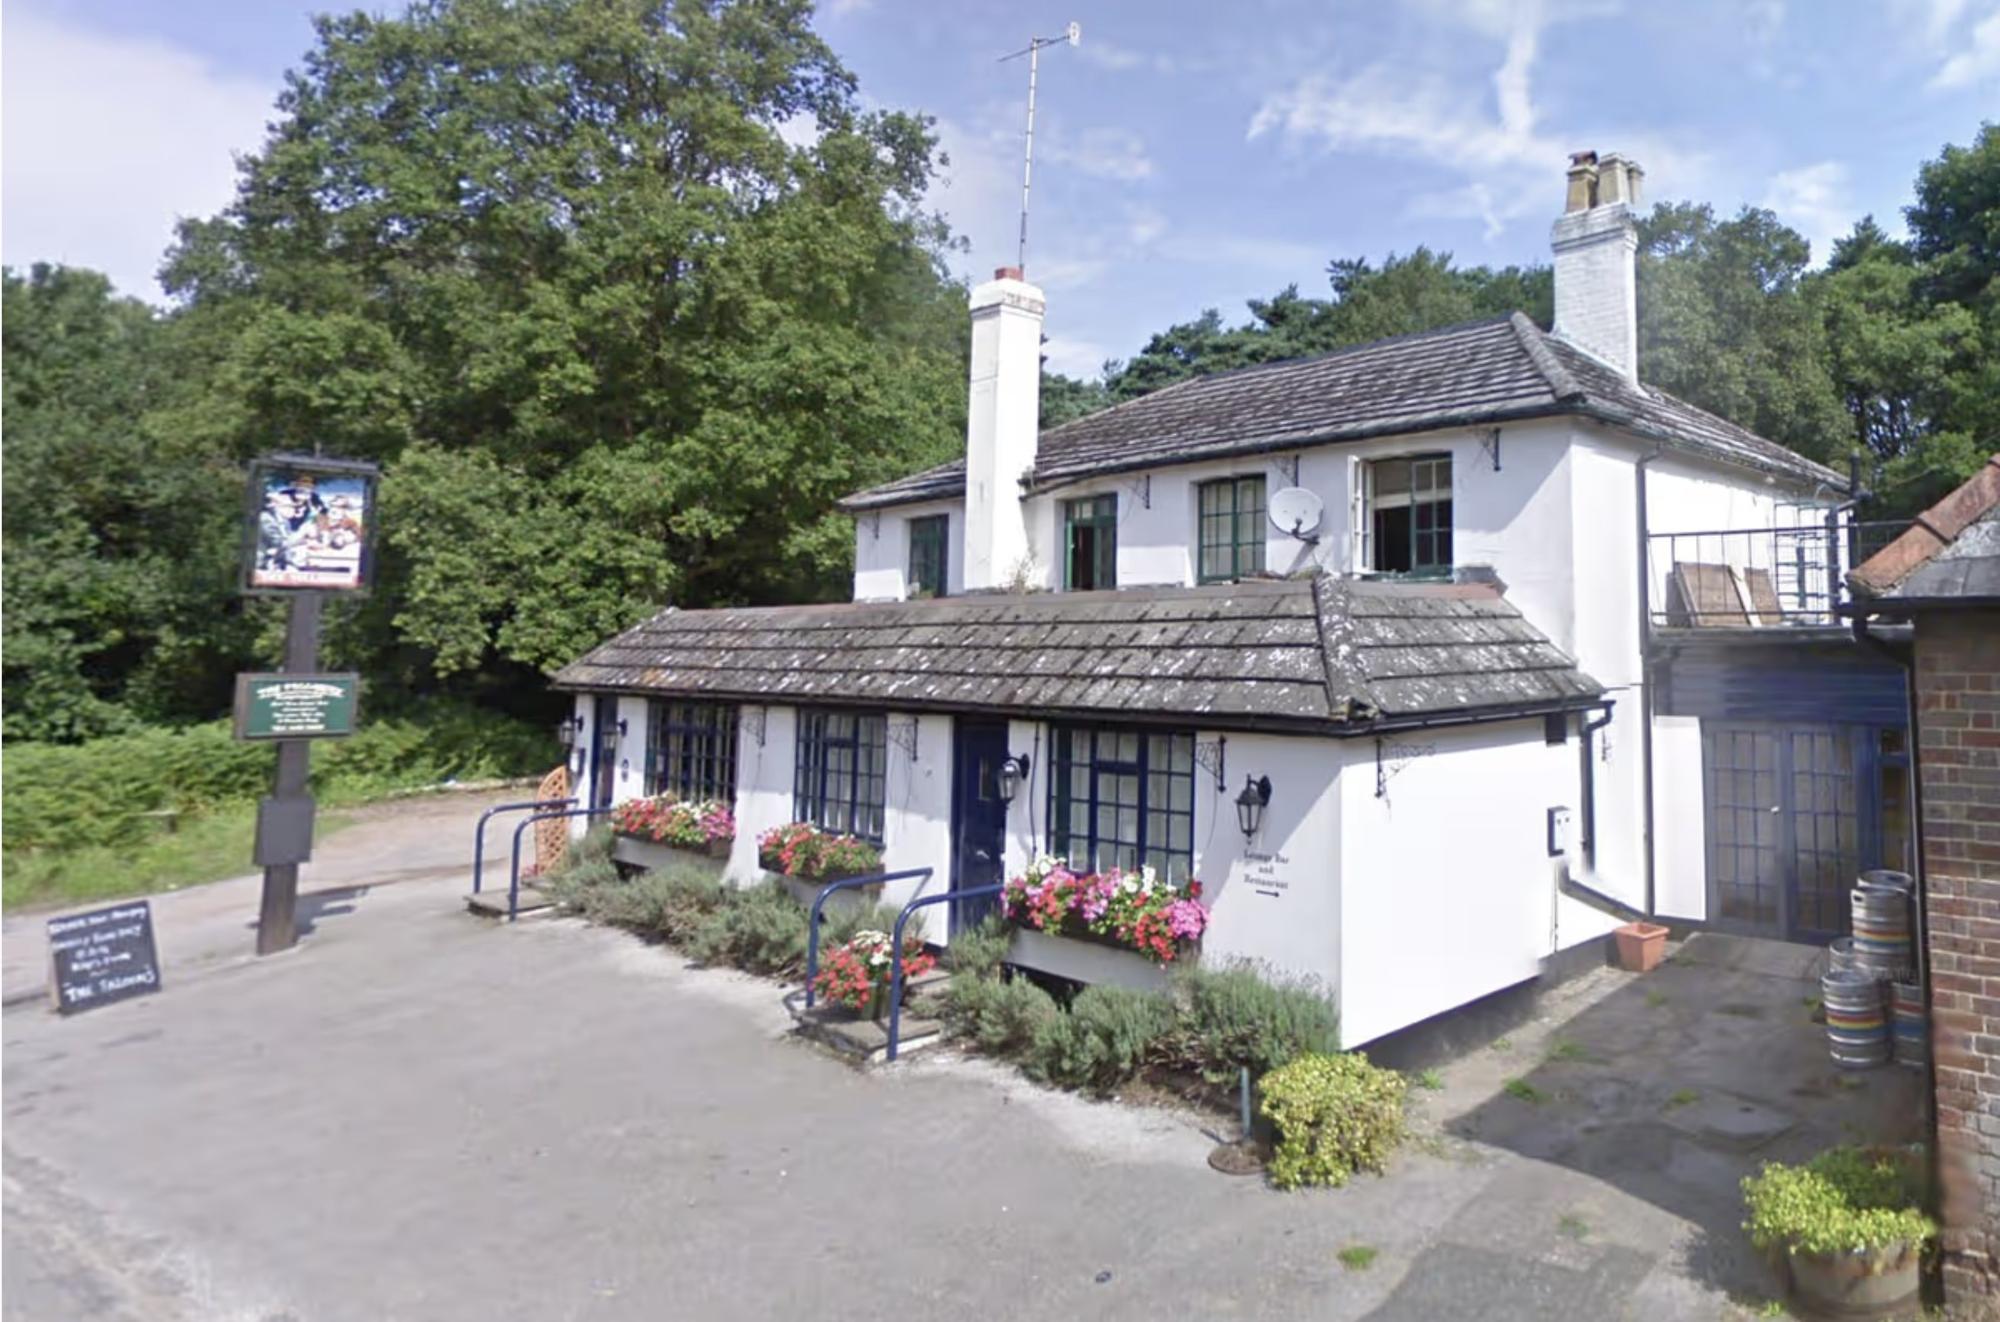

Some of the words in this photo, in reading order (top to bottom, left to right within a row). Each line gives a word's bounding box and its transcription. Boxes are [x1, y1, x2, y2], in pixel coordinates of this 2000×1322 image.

[1243, 849, 1272, 863] Lounge
[1275, 852, 1289, 864] Bar
[1258, 864, 1274, 875] and
[1243, 873, 1290, 889] Restaurant
